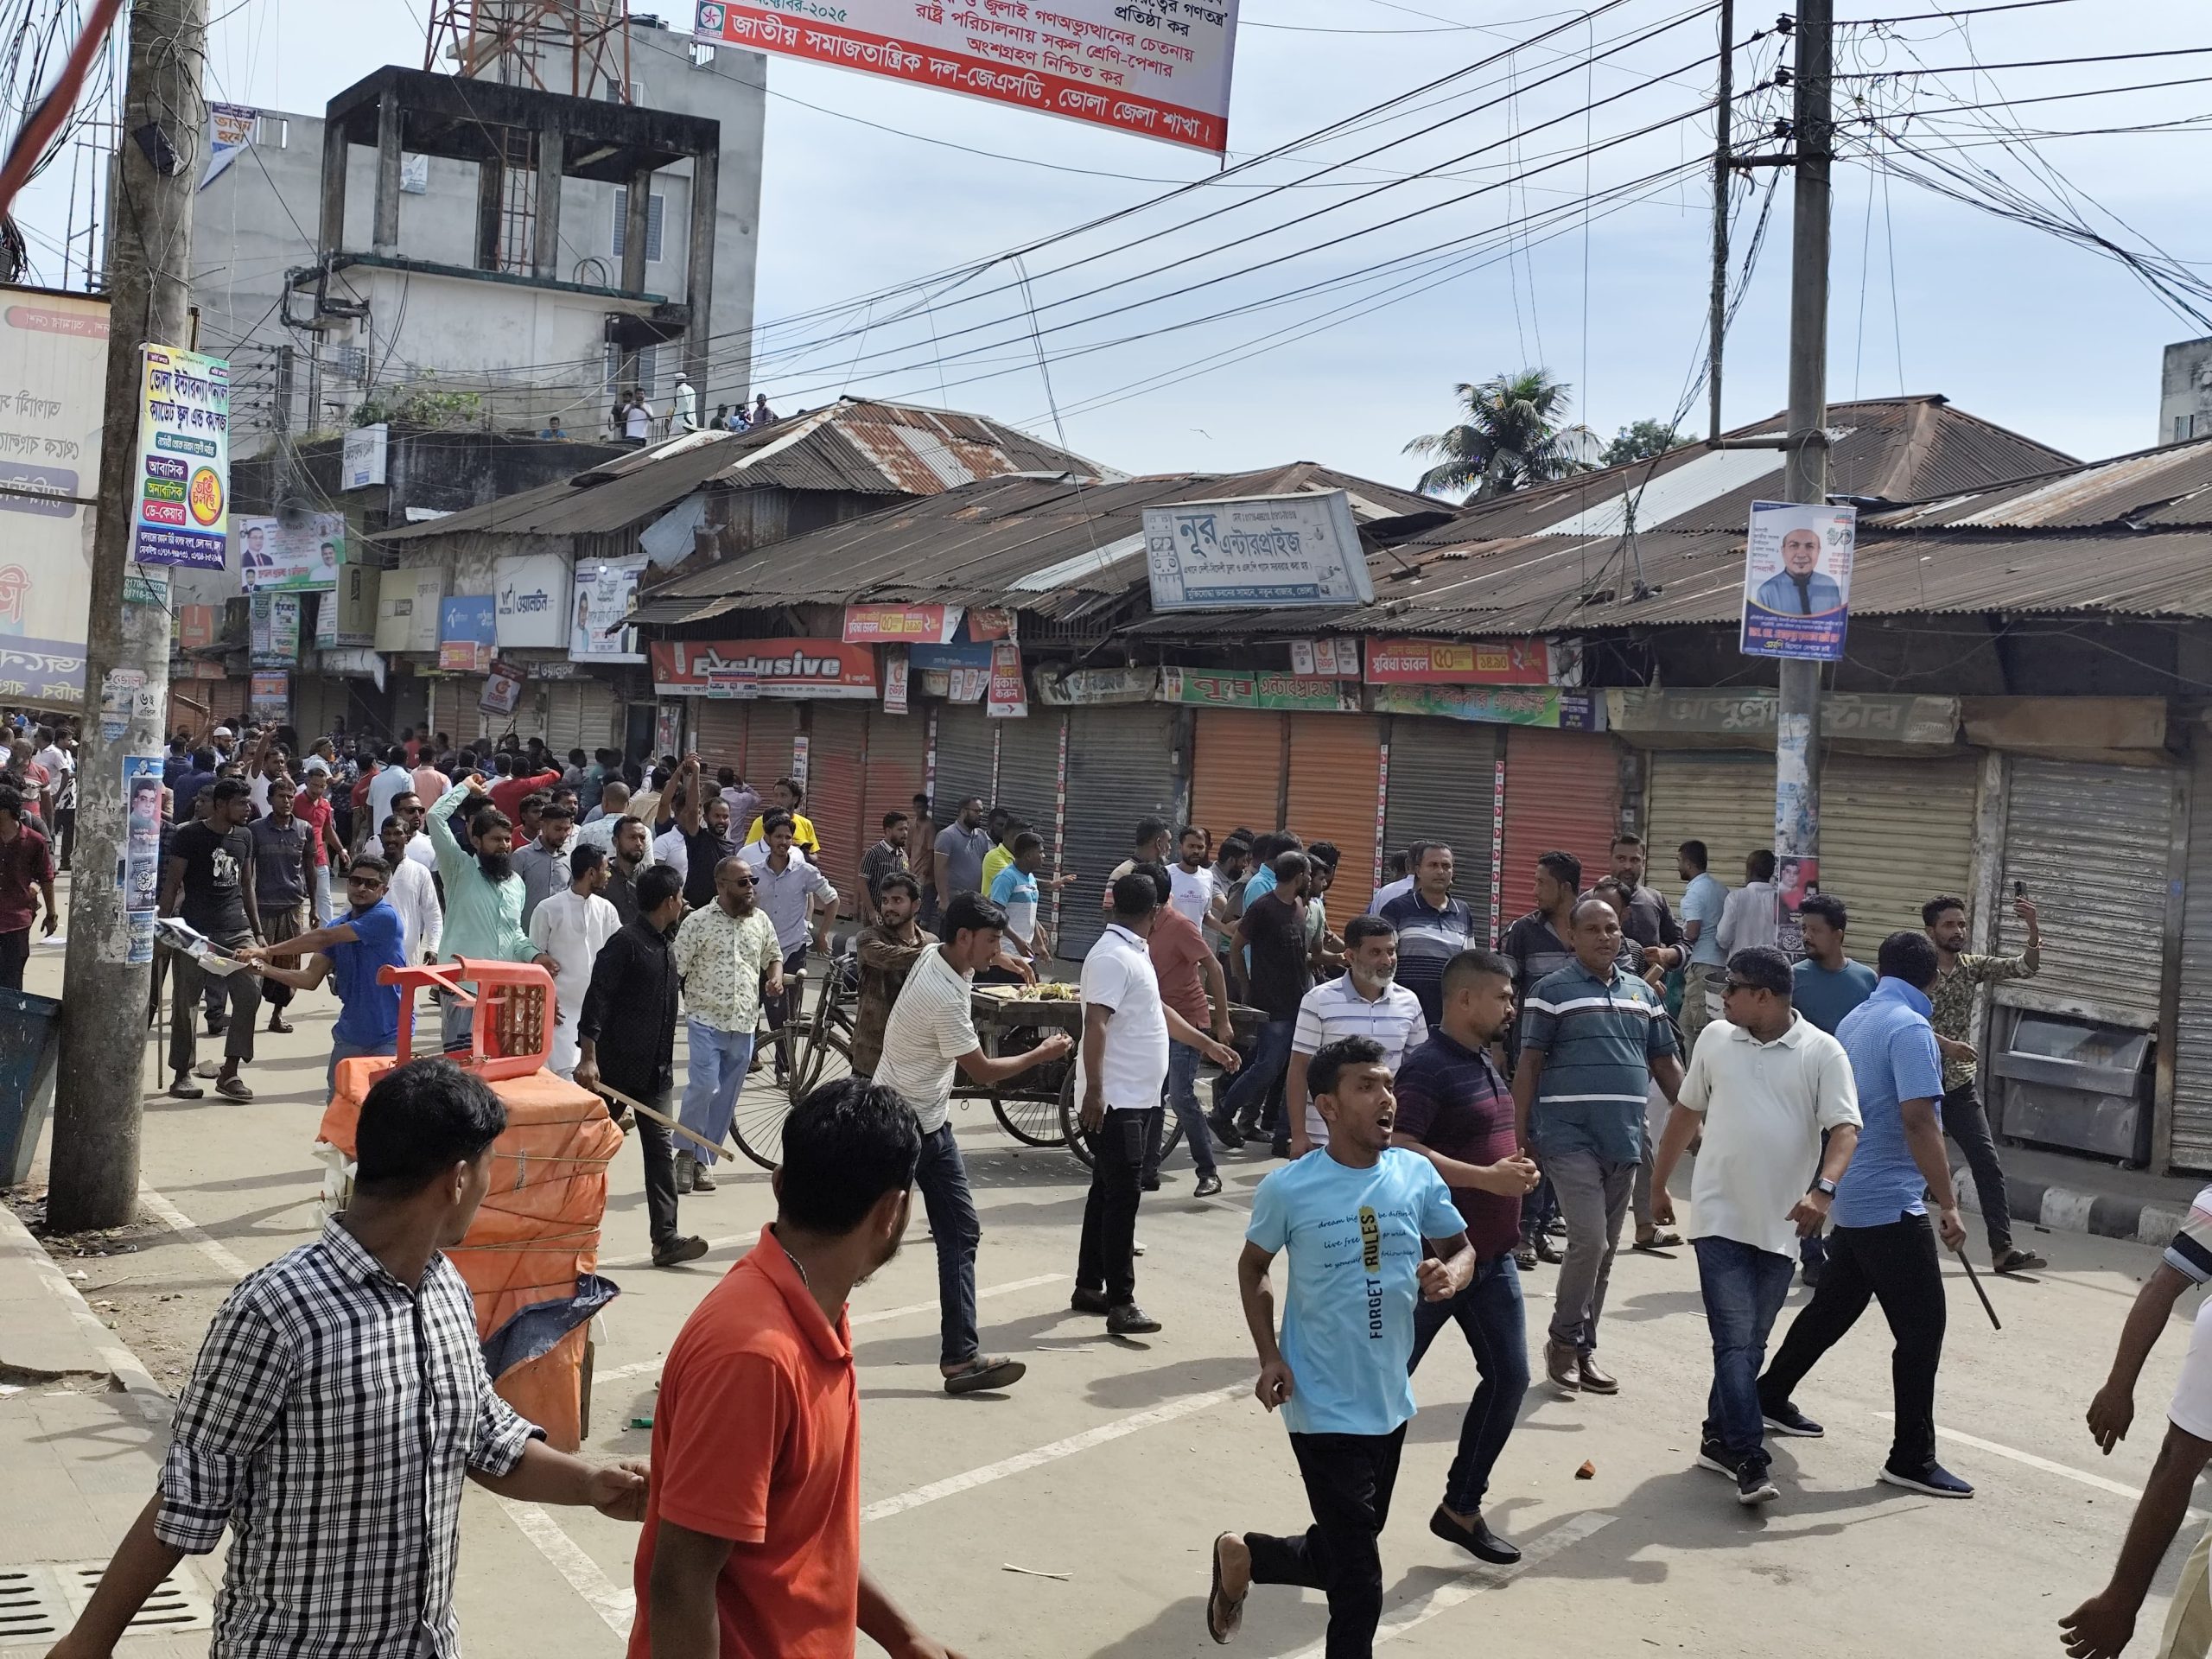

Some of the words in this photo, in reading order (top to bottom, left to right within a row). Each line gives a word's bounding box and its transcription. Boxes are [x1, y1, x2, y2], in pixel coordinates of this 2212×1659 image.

[915, 3, 944, 25] রাষ্ট্র
[951, 11, 1037, 43] পরিচালনায়
[1042, 33, 1082, 55] সকল
[1115, 5, 1162, 29] প্রতিষ্ঠা
[1167, 21, 1191, 37] কর
[966, 37, 1038, 66] অংশগ্রহণ
[1042, 51, 1093, 78] নিশ্চিত
[1099, 68, 1125, 86] কর
[1141, 38, 1195, 63] চেতনায়
[731, 14, 800, 48] জাতীয়
[805, 29, 924, 73] সমাজতান্ত্রিক
[1059, 88, 1109, 118] ভোলা
[1113, 100, 1158, 129] জেলা
[149, 369, 172, 394] ভোলা
[206, 410, 226, 432] কলেজ
[149, 460, 184, 478] আবাসিক
[148, 482, 183, 499] অনাবাসিক
[196, 475, 213, 493] ভর্তি
[146, 505, 183, 522] ডে-কেয়ার
[193, 492, 216, 514] চলছে
[1175, 514, 1217, 558] নূর
[1219, 526, 1302, 557] এন্টারপ্রাইজ
[517, 588, 548, 613] ওয়ালটন
[1372, 653, 1398, 672] সুবিধা
[1402, 657, 1429, 671] ডাবল
[1434, 649, 1453, 668] ৫০
[995, 689, 1018, 699] করুন
[1318, 1219, 1344, 1230] dream
[1346, 1214, 1357, 1224] big
[1324, 1239, 1343, 1249] live
[1344, 1236, 1360, 1247] free
[1361, 1214, 1379, 1267] RULES
[1367, 1278, 1382, 1339] FORGET
